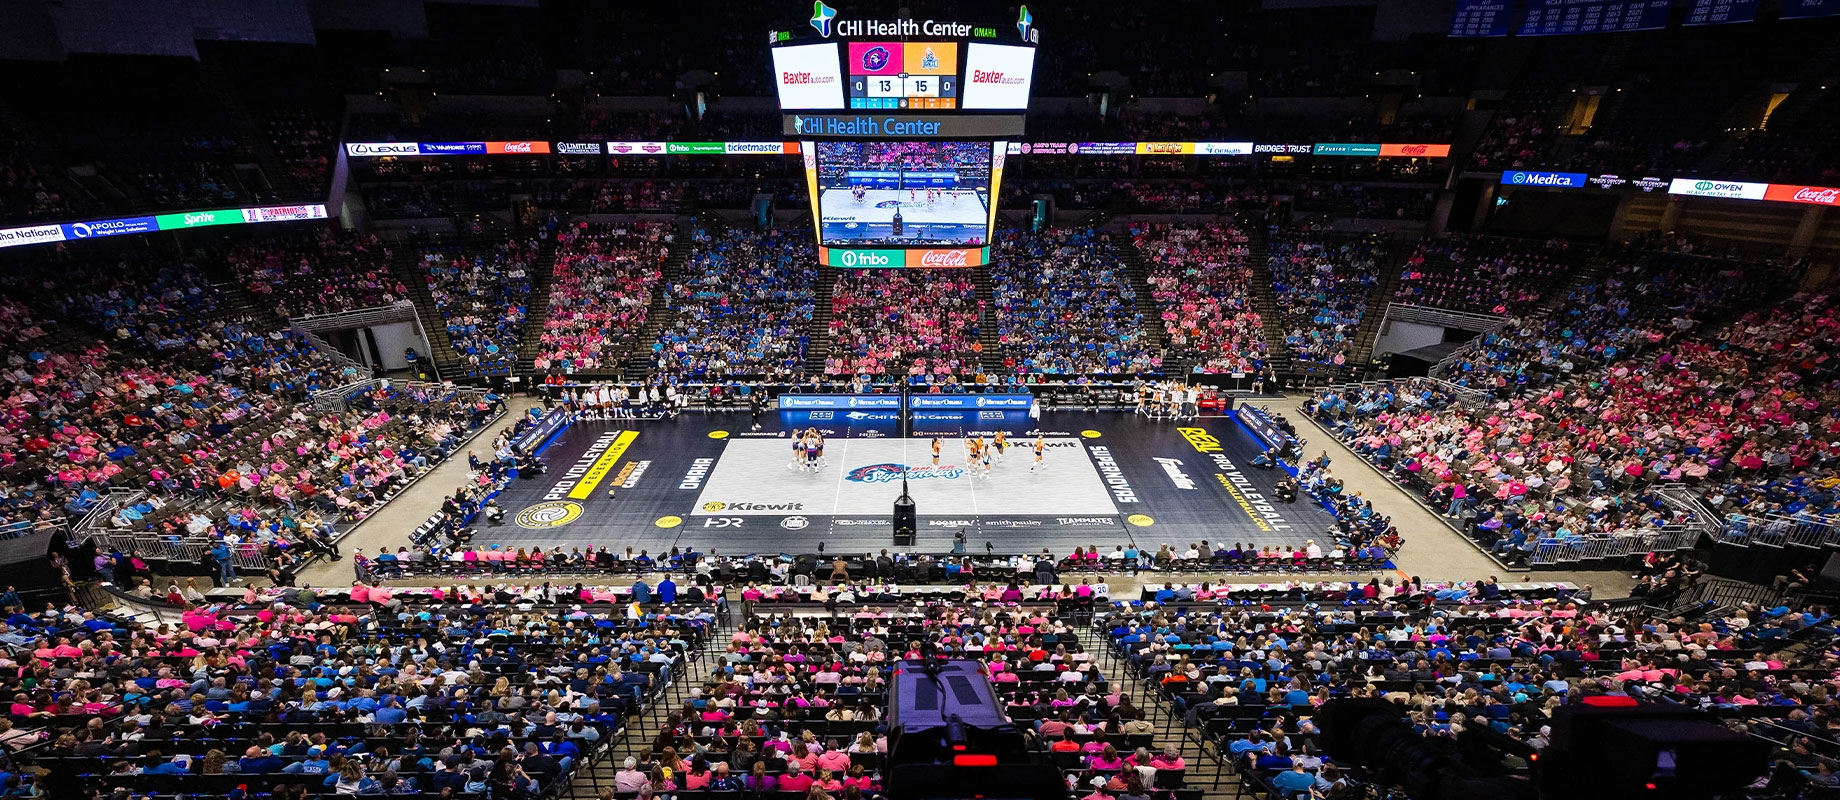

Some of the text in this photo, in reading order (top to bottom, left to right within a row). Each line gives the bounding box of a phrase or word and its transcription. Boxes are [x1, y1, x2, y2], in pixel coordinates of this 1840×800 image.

[837, 19, 996, 38] CHI Health Center OMAHA
[855, 81, 863, 91] 0
[879, 80, 891, 92] 13
[915, 80, 927, 92] 15
[944, 81, 950, 91] 0
[803, 116, 941, 135] CHI Health Center
[504, 142, 531, 152] Coca-Cola
[728, 143, 781, 152] ticketmaster
[1255, 145, 1311, 153] BRIDGES TRUST
[1714, 183, 1743, 191] OWEN
[1793, 187, 1840, 203] Coca-Cola
[184, 213, 215, 226] Sprite
[91, 222, 124, 230] APOLLO
[16, 228, 60, 239] National
[858, 250, 888, 264] fnbo
[922, 250, 966, 266] Coca-Cola
[542, 481, 575, 500] PRO
[562, 430, 621, 479] VOLLEYBALL
[584, 443, 625, 485] FEDERATION
[679, 458, 714, 490] OMAHA
[1088, 446, 1140, 503] SUPERNOVAS
[1177, 427, 1291, 531] REAL PRO VOLLEYBALL
[727, 503, 803, 511] Kiewit
[1214, 473, 1272, 532] PROVOLLEYBALL.COM
[704, 518, 743, 528] HDR
[1097, 586, 1106, 594] 20
